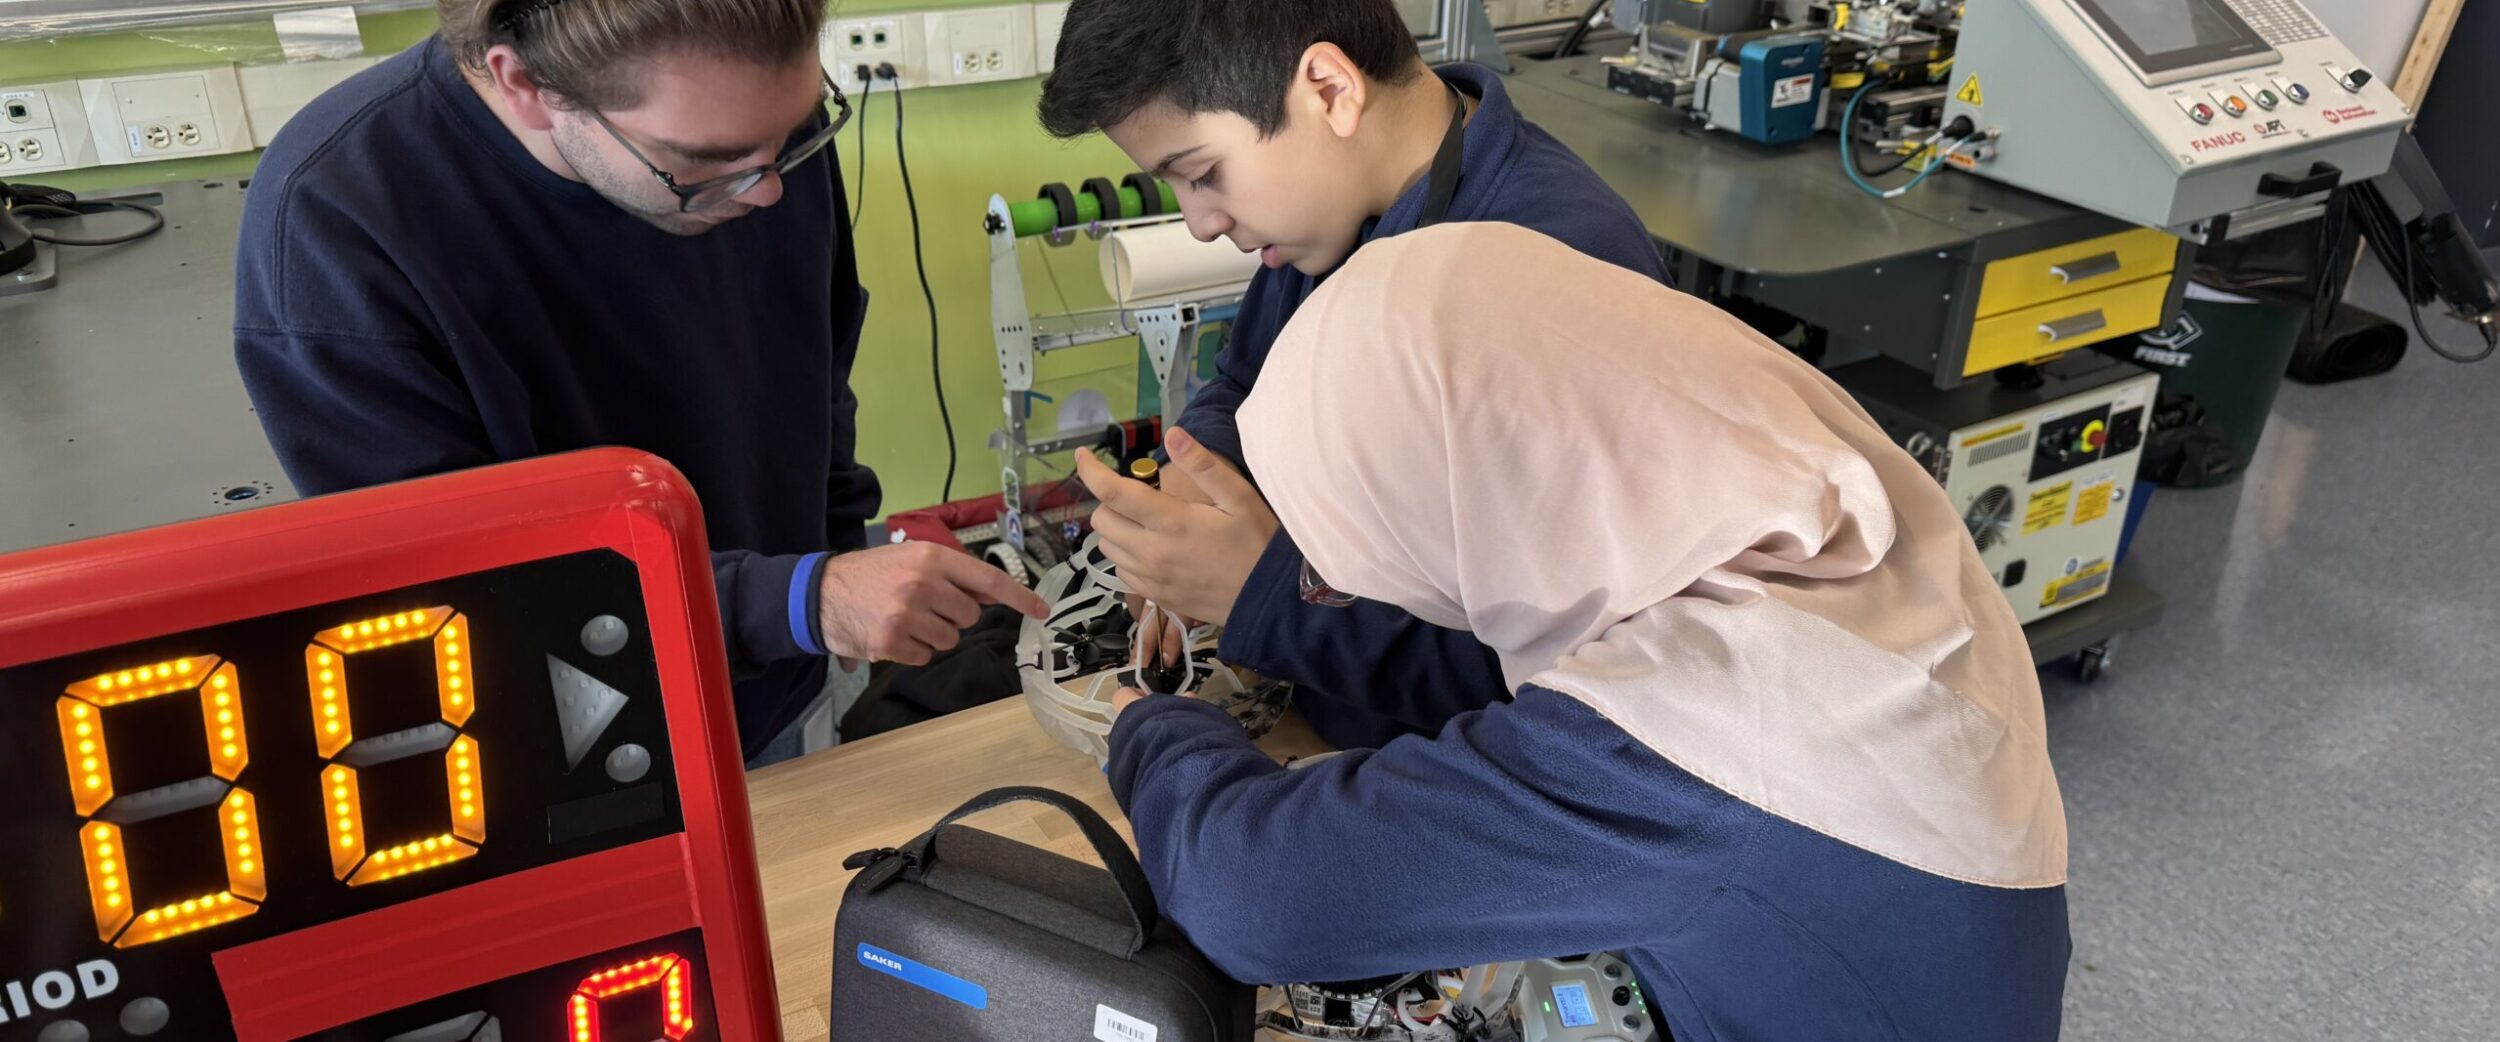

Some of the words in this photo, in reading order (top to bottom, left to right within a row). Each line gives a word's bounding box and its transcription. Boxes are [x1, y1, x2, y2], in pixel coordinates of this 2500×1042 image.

[2191, 131, 2247, 152] FANUC
[2133, 345, 2193, 368] FIRST
[863, 950, 903, 972] SAKER
[0, 959, 119, 1024] IOD
